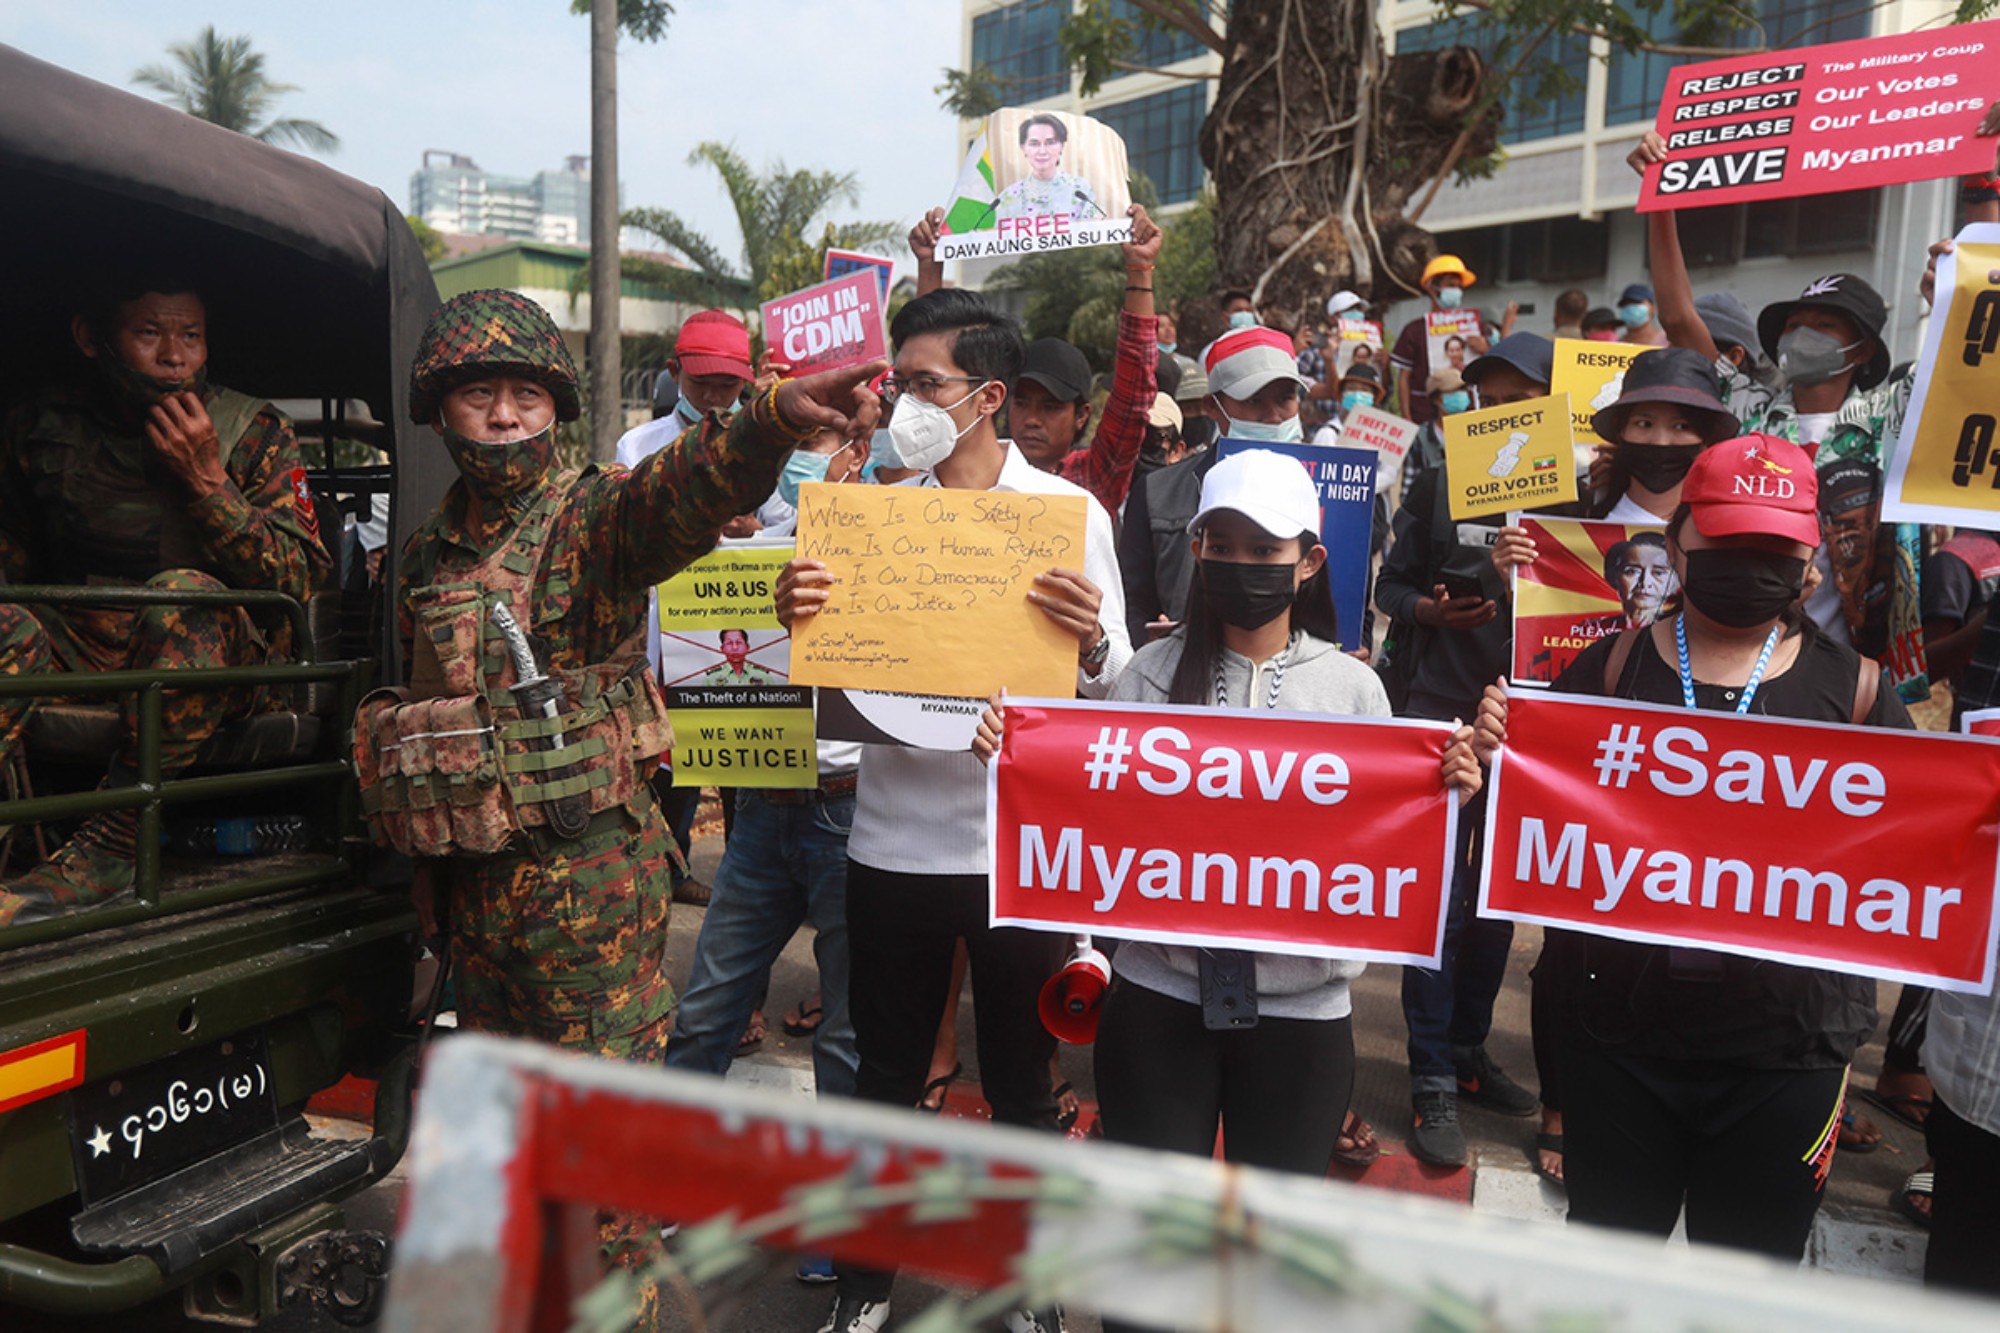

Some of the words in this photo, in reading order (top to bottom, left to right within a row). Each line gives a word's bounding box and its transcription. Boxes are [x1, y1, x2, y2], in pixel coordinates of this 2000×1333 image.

[1682, 64, 1804, 96] REJECT
[1822, 63, 1856, 73] The
[1859, 51, 1928, 69] Military
[1932, 43, 1984, 57] Coup
[1675, 91, 1798, 121] RESPECT
[1815, 86, 1870, 103] Our
[1876, 73, 1959, 95] Votes
[1669, 117, 1792, 149] RELEASE
[1809, 114, 1862, 132] Our
[1868, 97, 1985, 124] Leaders
[1659, 148, 1786, 193] SAVE
[1801, 135, 1964, 171] Myanmar
[998, 213, 1071, 240] FREE
[944, 243, 981, 259] DAW
[984, 237, 1033, 254] AUNG
[1038, 233, 1072, 250] SAN
[1078, 229, 1101, 245] SU
[772, 293, 830, 334] "JOIN
[833, 285, 859, 313] IN
[783, 302, 871, 361] CDM"
[1357, 414, 1388, 433] THEFT
[1466, 410, 1544, 438] RESPECT
[1344, 426, 1363, 440] THE
[1363, 432, 1405, 457] NATION
[1320, 462, 1338, 480] IN
[1341, 464, 1372, 484] DAY
[1465, 481, 1500, 498] OUR
[1503, 472, 1558, 491] VOTES
[1327, 483, 1370, 502] NIGHT
[1466, 492, 1515, 507] MYANMAR
[1516, 485, 1559, 499] CITIZENS
[1731, 474, 1796, 499] NLD
[805, 495, 867, 528] Where
[881, 496, 906, 527] Is
[923, 497, 959, 525] Our
[802, 532, 854, 558] Where
[860, 532, 884, 557] Is
[892, 534, 929, 556] Our
[939, 536, 994, 557] Human
[693, 562, 720, 574] people
[731, 561, 760, 572] Burma
[849, 562, 868, 587] Is
[877, 565, 909, 586] Our
[694, 582, 722, 599] UN
[726, 581, 739, 598] &
[743, 580, 769, 597] US
[847, 591, 865, 614] Is
[874, 593, 901, 614] Our
[668, 606, 681, 617] for
[682, 607, 708, 618] every
[709, 604, 739, 616] action
[740, 606, 758, 618] you
[679, 692, 700, 704] The
[702, 691, 734, 704] Theft
[736, 691, 747, 704] of
[749, 694, 758, 703] a
[759, 691, 801, 703] Nation!
[920, 702, 980, 716] MYANMAR
[700, 727, 726, 741] WE
[733, 727, 785, 741] WANT
[681, 748, 809, 768] JUSTICE!
[1083, 726, 1351, 806] #Save
[1592, 723, 1887, 818] #Save
[1018, 823, 1418, 919] Myanmar
[1514, 815, 1962, 941] Myanmar
